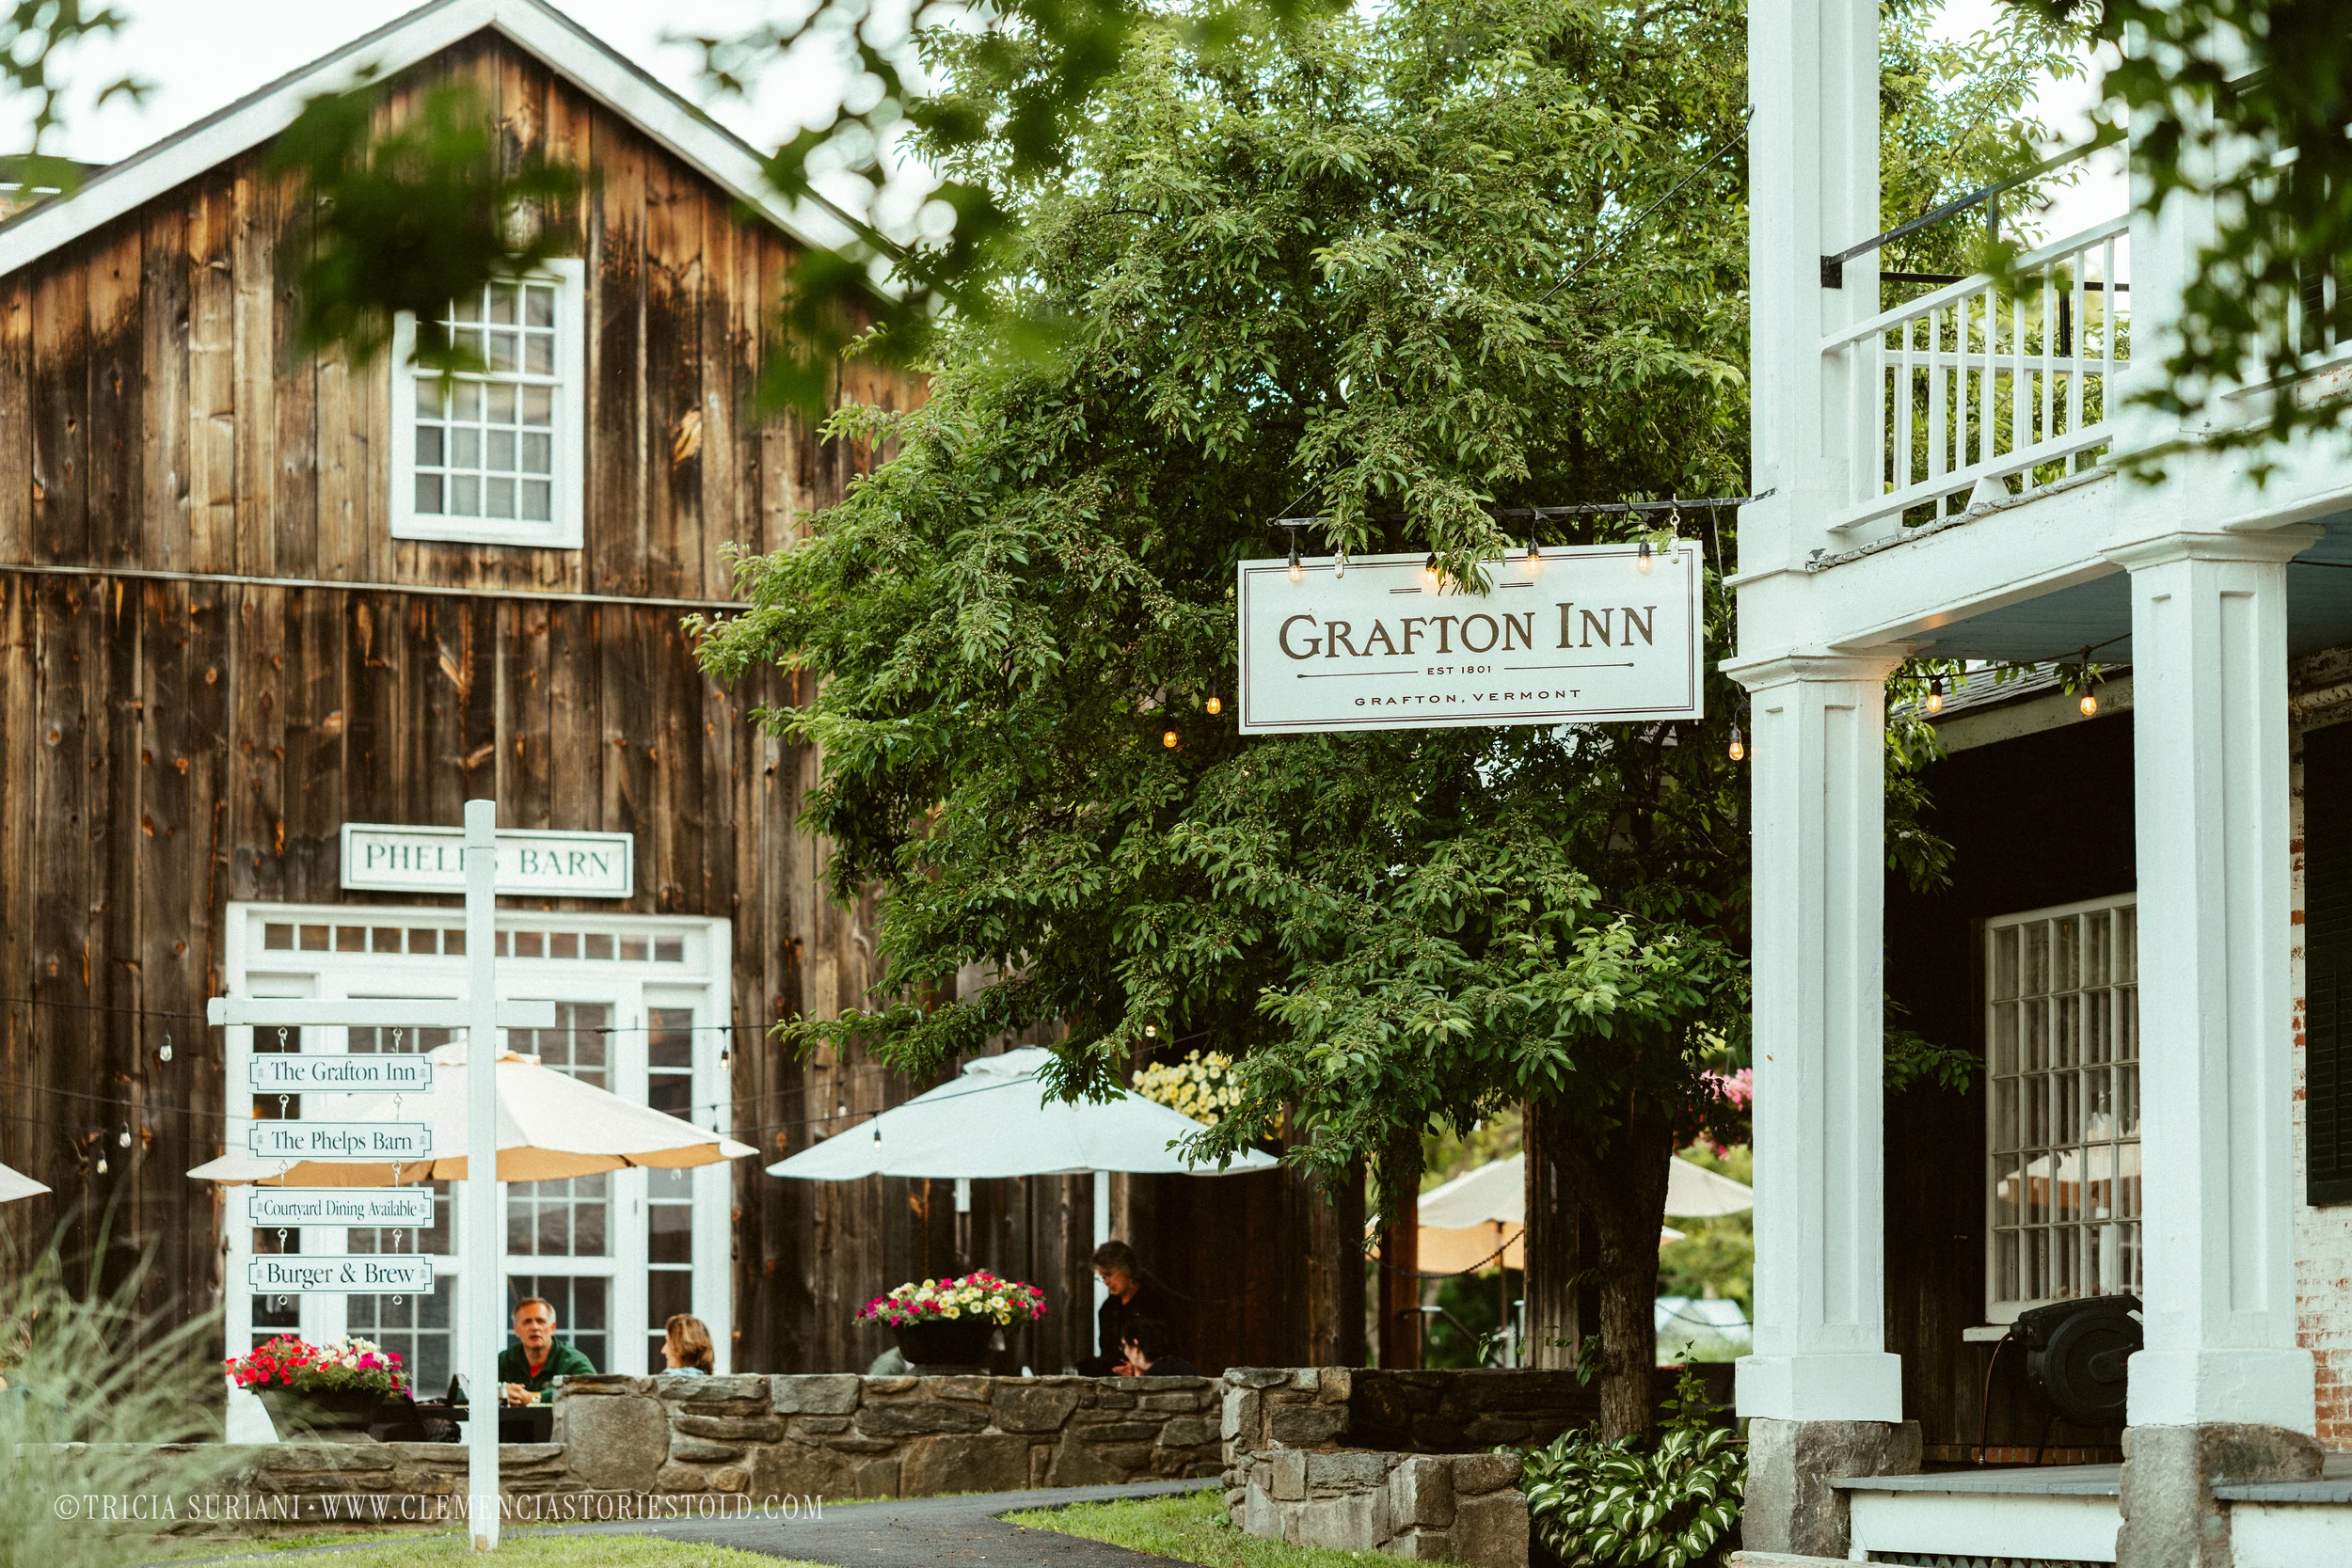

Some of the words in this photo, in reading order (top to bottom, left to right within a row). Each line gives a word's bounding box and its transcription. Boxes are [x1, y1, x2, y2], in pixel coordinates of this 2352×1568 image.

[1279, 611, 1536, 659] GRAFTON
[1556, 602, 1658, 649] INN
[1427, 667, 1454, 675] EST
[1460, 665, 1492, 674] 1801
[1355, 693, 1466, 706] GRAFTON,
[1472, 689, 1581, 702] VERMONT
[365, 845, 499, 872] PHEL
[519, 848, 609, 877] BARN
[271, 1062, 305, 1081] The
[311, 1061, 378, 1081] Grafton
[386, 1063, 416, 1080] Inn
[271, 1131, 305, 1149] The
[311, 1131, 366, 1155] Phelps
[373, 1132, 413, 1149] Barn
[263, 1199, 322, 1220] Courtyard
[326, 1199, 365, 1220] Dining
[368, 1200, 418, 1216] Available
[267, 1263, 333, 1290] Burger
[340, 1262, 357, 1283] &
[364, 1263, 415, 1283] Brew
